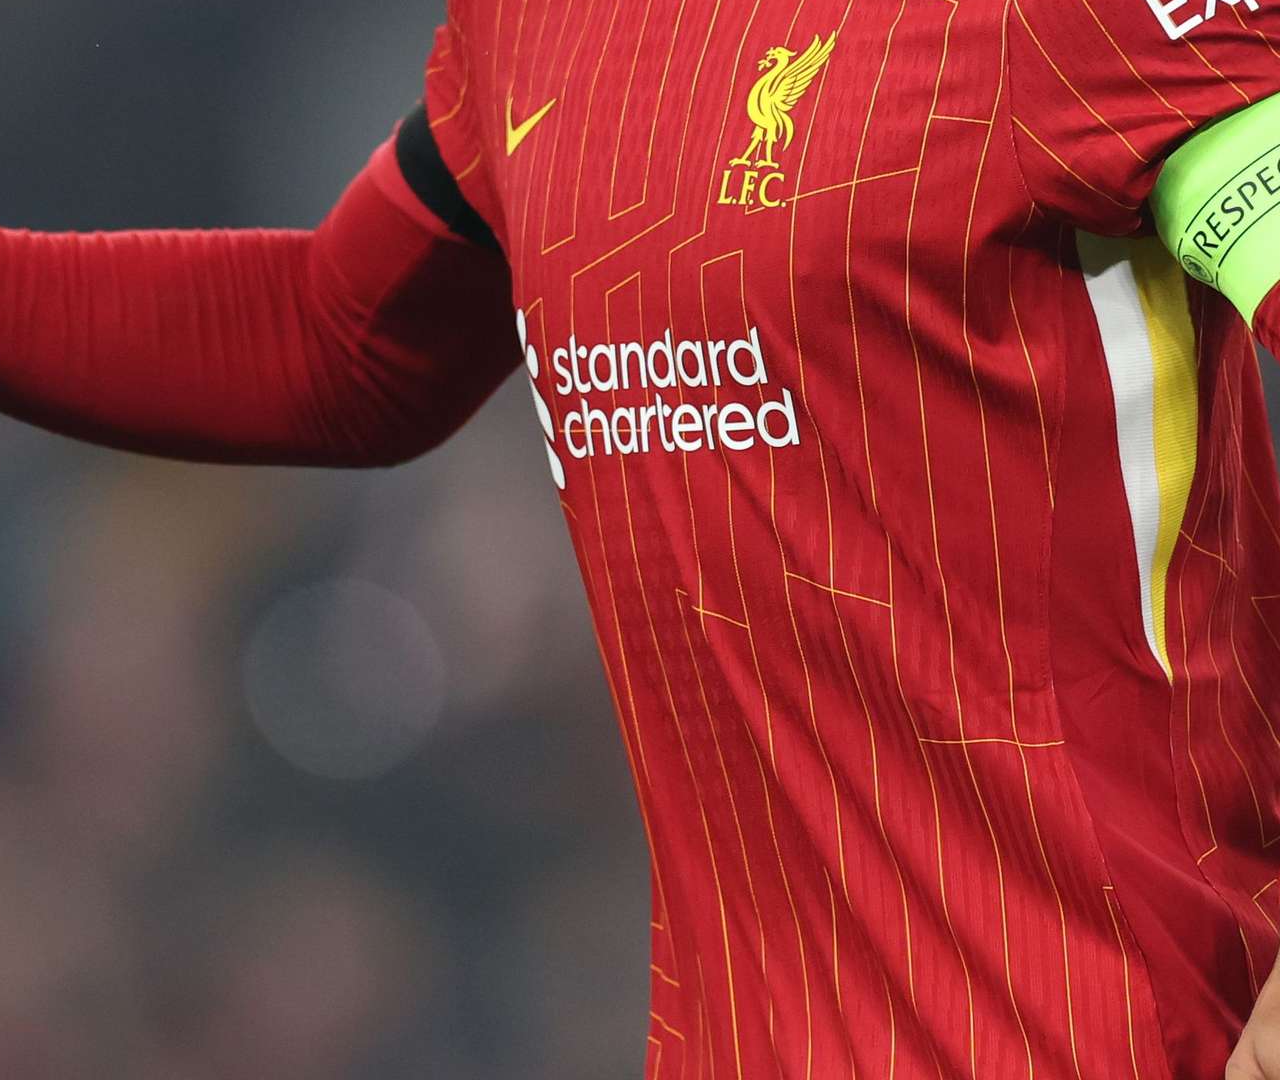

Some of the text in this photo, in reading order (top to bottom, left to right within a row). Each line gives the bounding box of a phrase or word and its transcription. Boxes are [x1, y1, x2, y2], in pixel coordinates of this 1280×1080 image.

[717, 170, 787, 208] L.F.C.
[552, 326, 769, 395] standard
[564, 387, 801, 459] chartered
